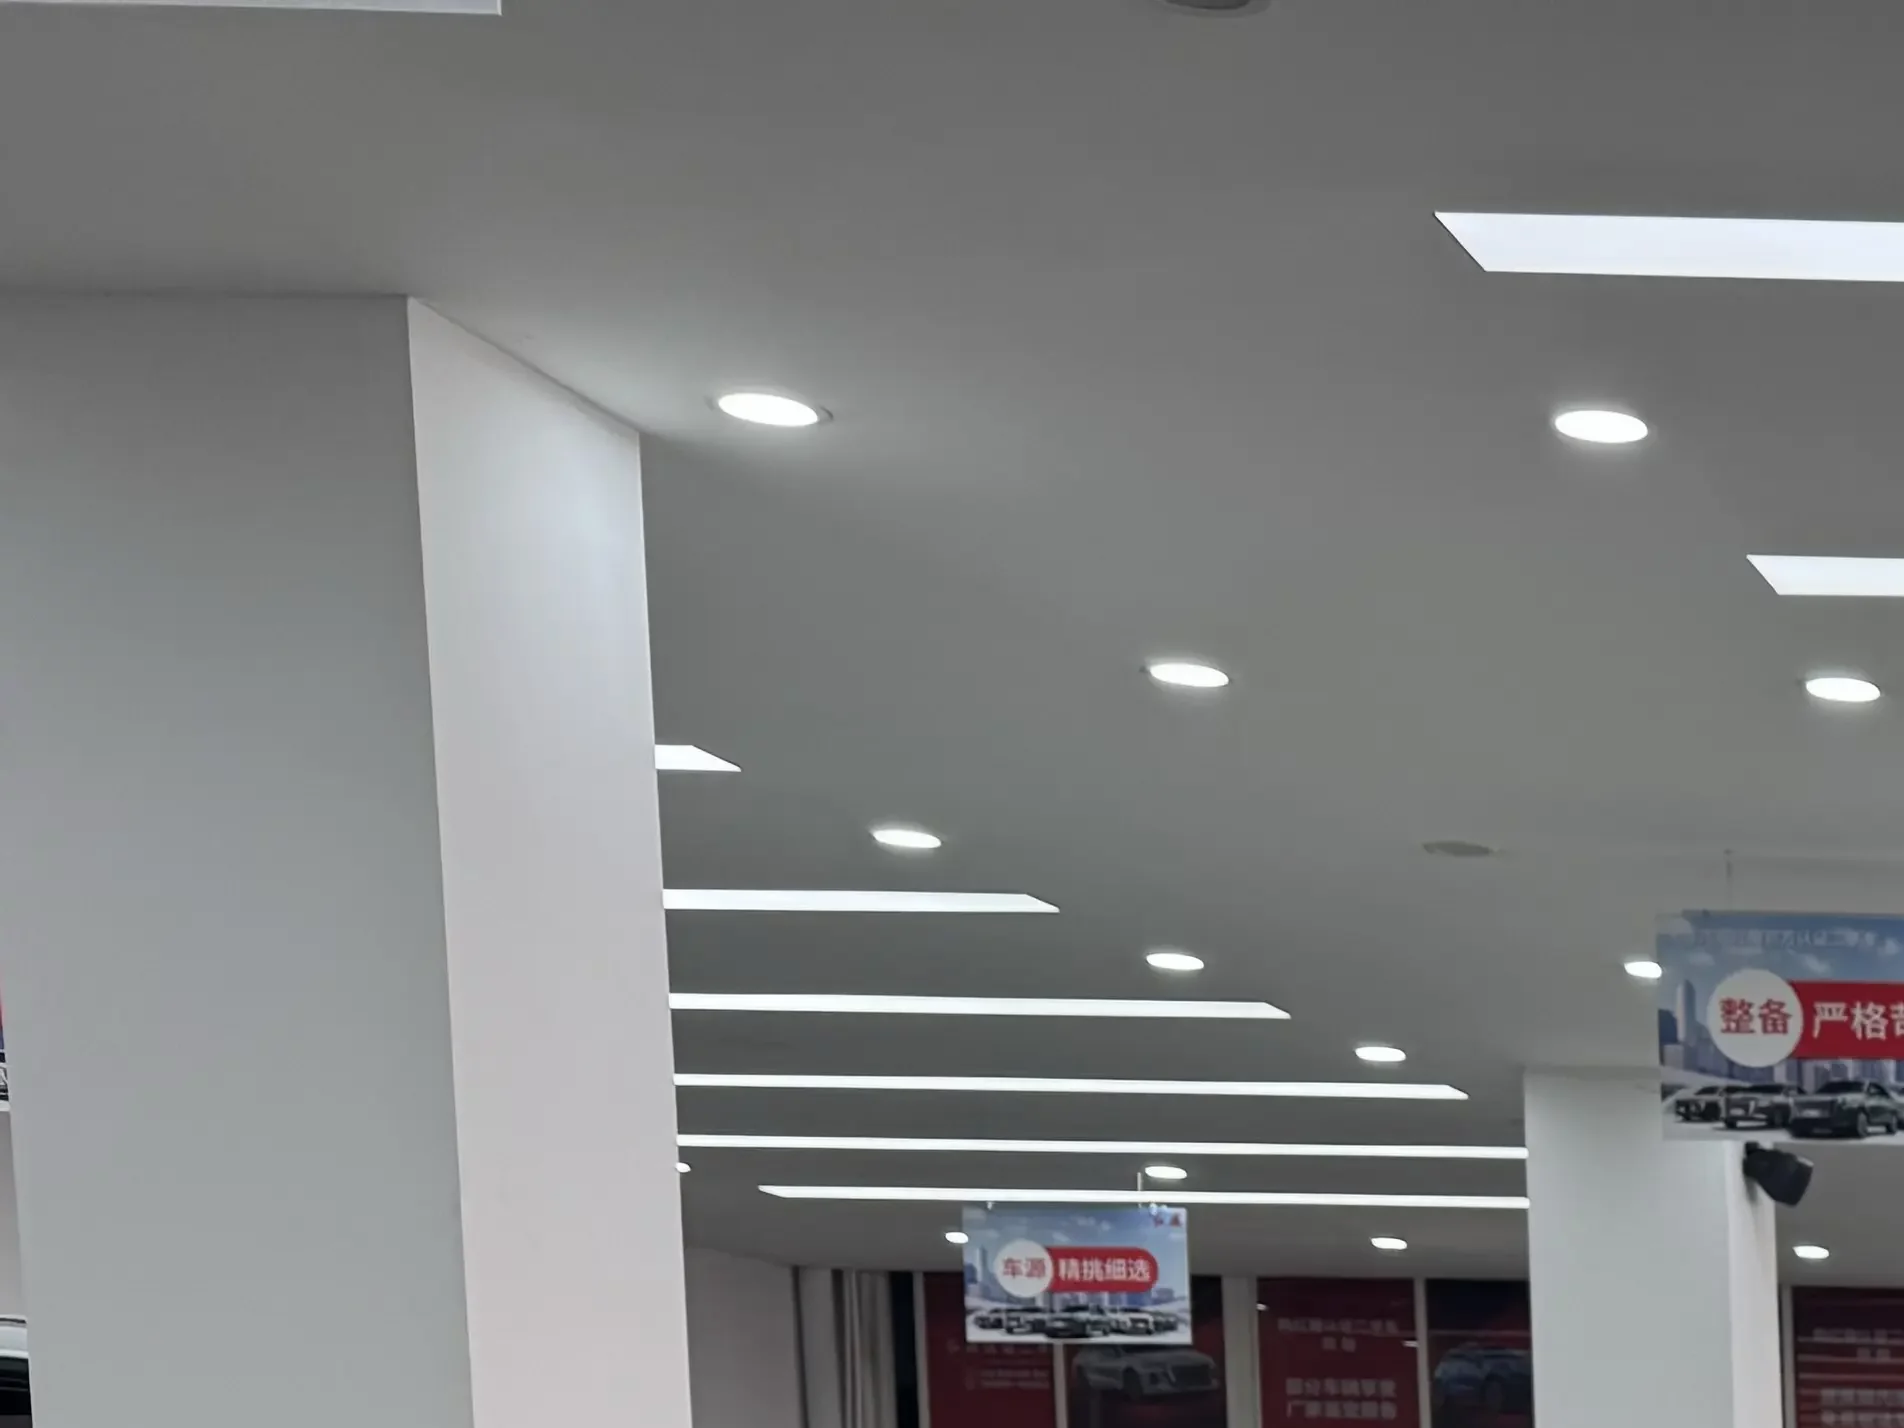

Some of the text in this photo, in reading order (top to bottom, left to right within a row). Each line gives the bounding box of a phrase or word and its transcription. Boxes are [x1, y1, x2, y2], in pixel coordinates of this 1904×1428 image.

[1719, 996, 1793, 1035] 整备
[1002, 1256, 1151, 1282] 车源 精挑细选
